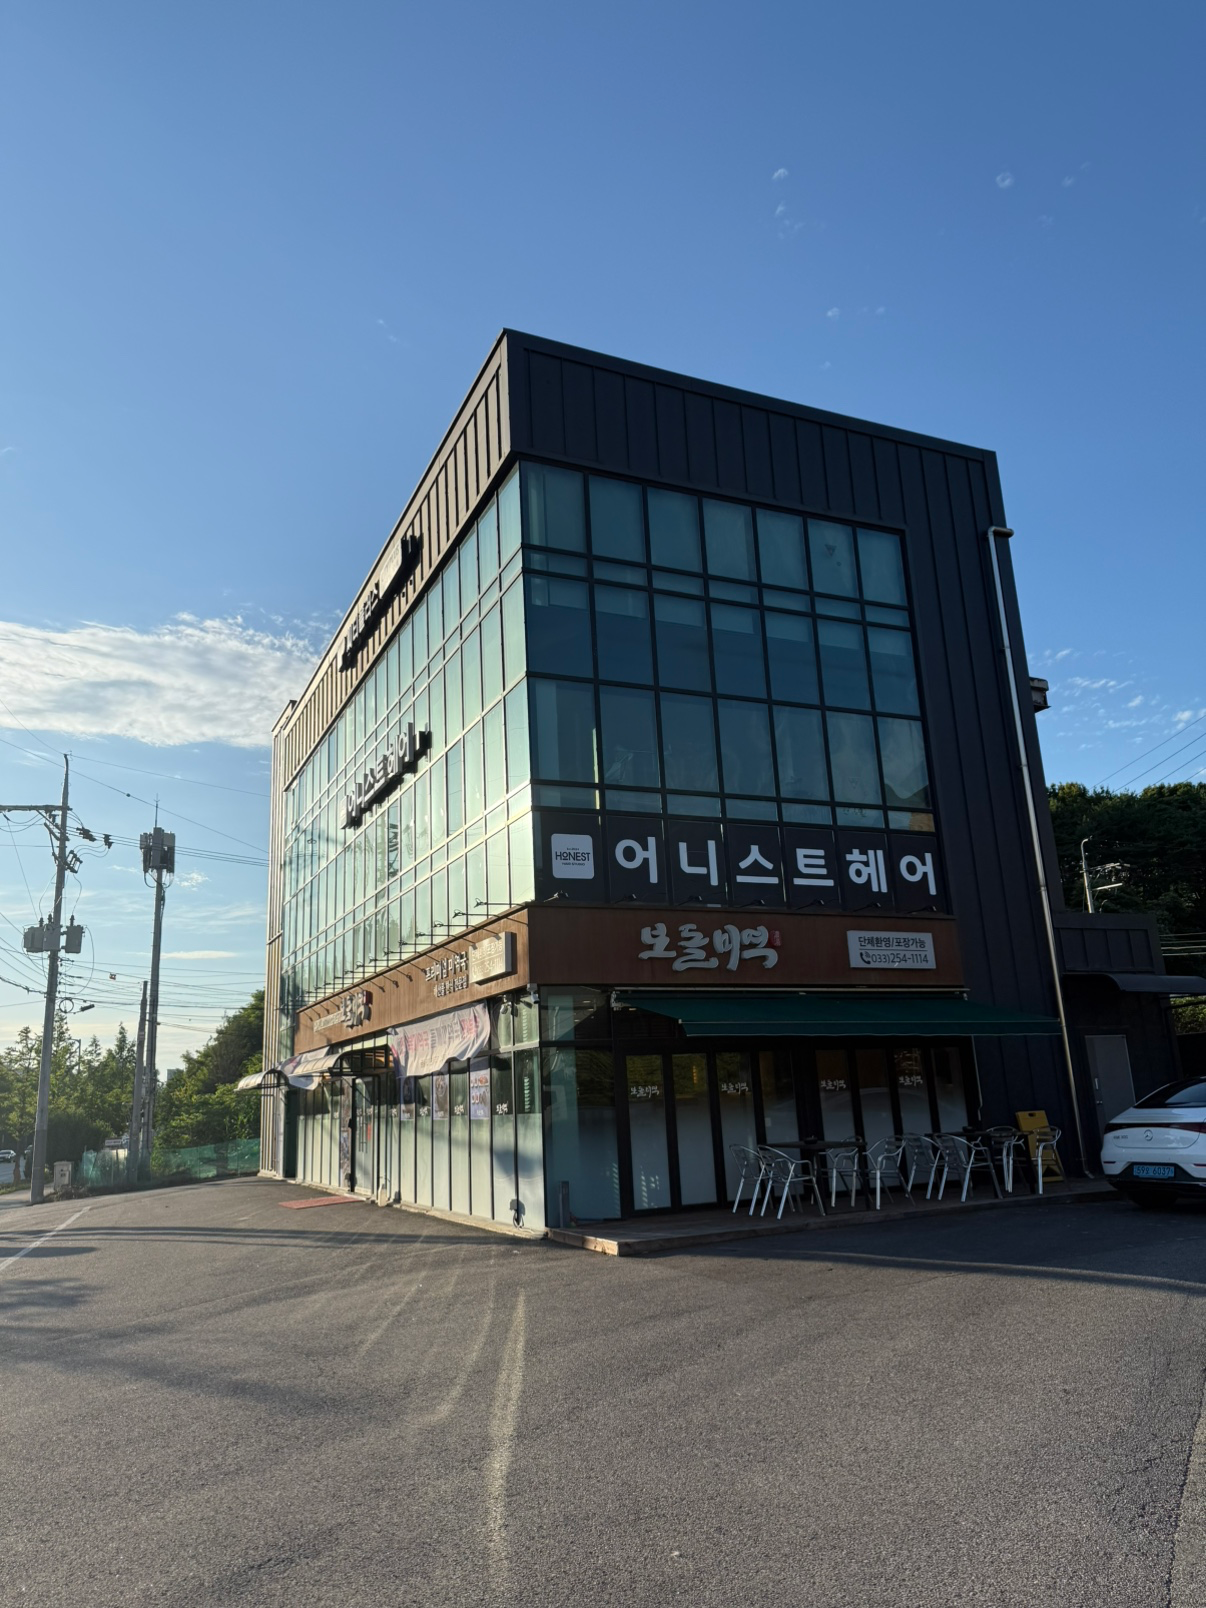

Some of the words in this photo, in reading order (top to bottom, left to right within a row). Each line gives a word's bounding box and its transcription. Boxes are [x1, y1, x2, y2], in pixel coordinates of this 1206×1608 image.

[346, 722, 415, 819] 어니스트헤어
[555, 851, 591, 861] HONEST
[615, 837, 937, 895] 어니스트헤어
[638, 923, 778, 972] 보들미역
[858, 936, 926, 948] 단체환영/포장가능
[871, 952, 929, 964] 033)254-1114
[1152, 1166, 1171, 1176] 6037
